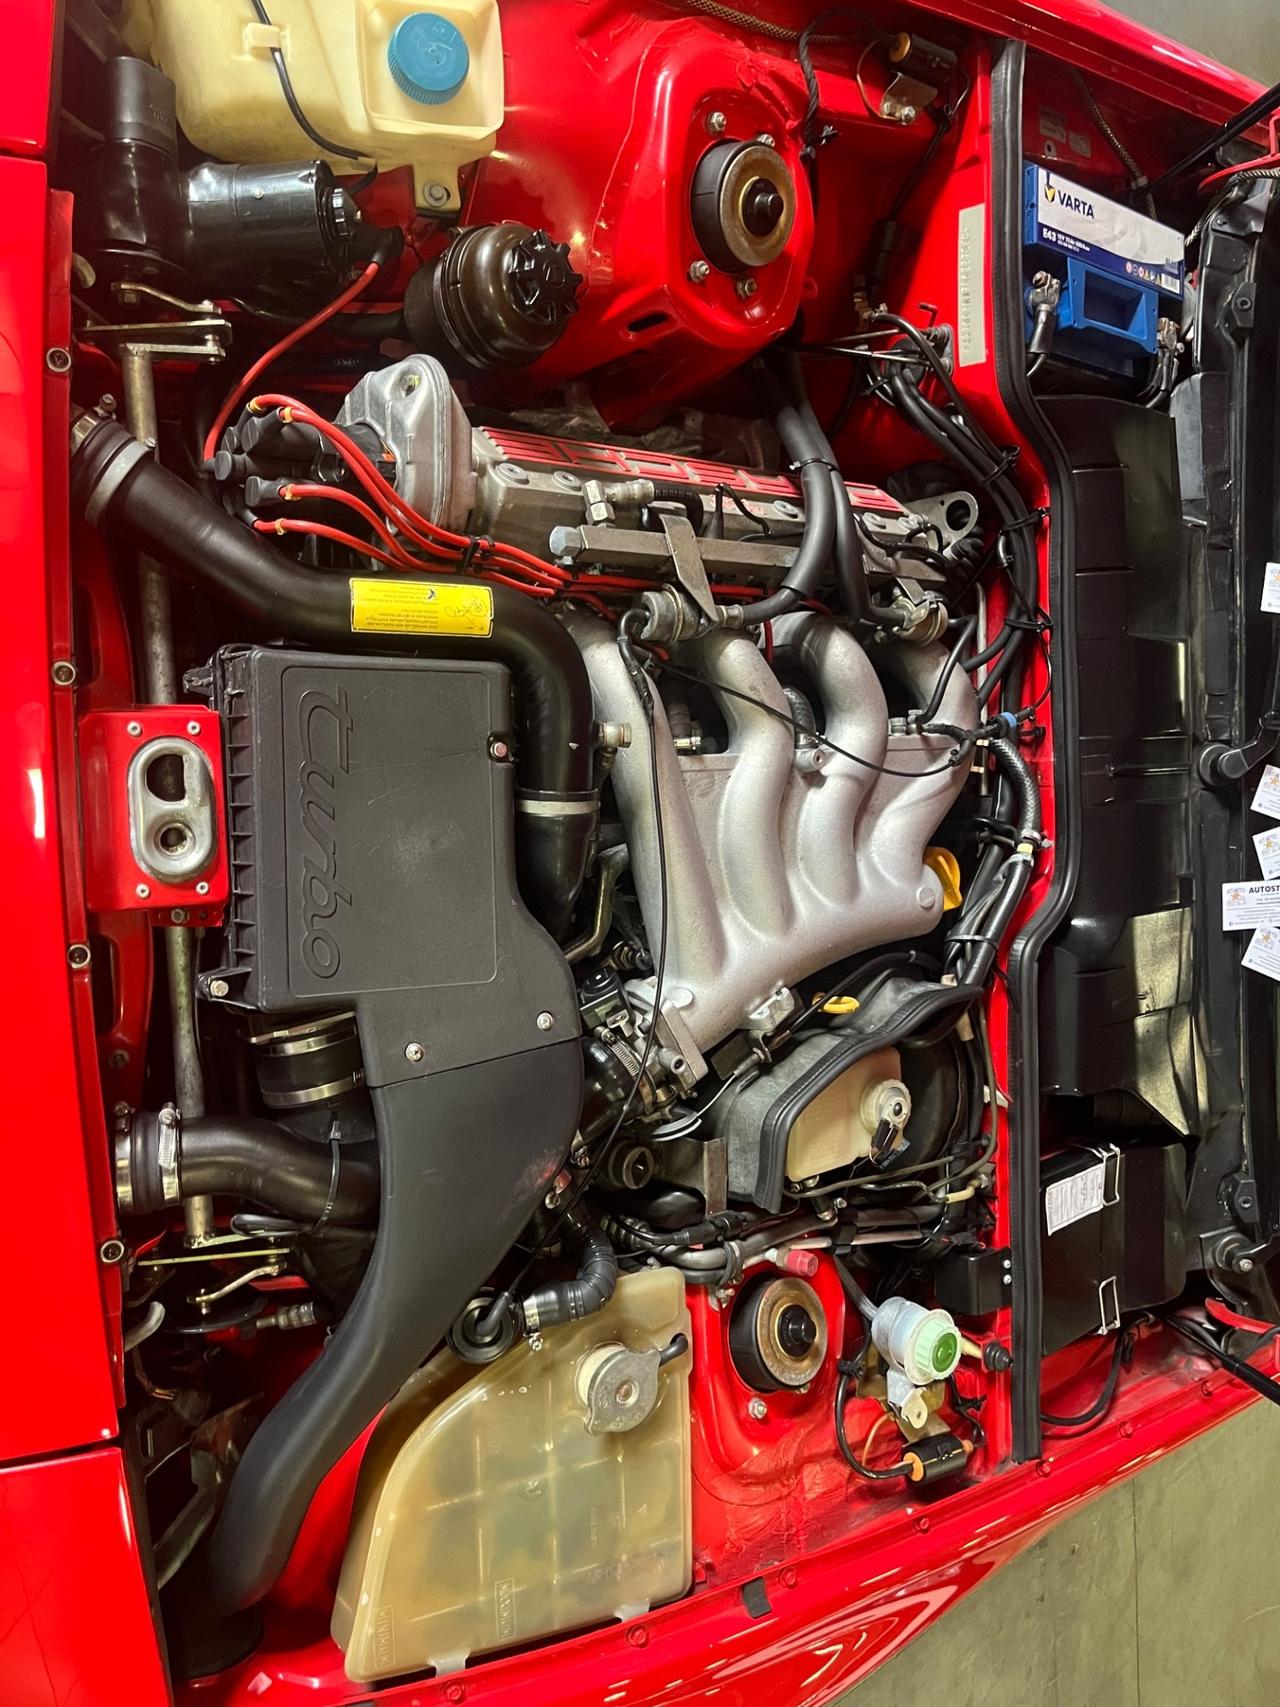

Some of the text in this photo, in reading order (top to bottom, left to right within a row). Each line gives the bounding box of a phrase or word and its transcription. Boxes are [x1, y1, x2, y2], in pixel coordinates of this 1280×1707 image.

[1057, 190, 1094, 219] VARTA
[1042, 227, 1057, 242] E43
[482, 427, 903, 511] PRSCHE
